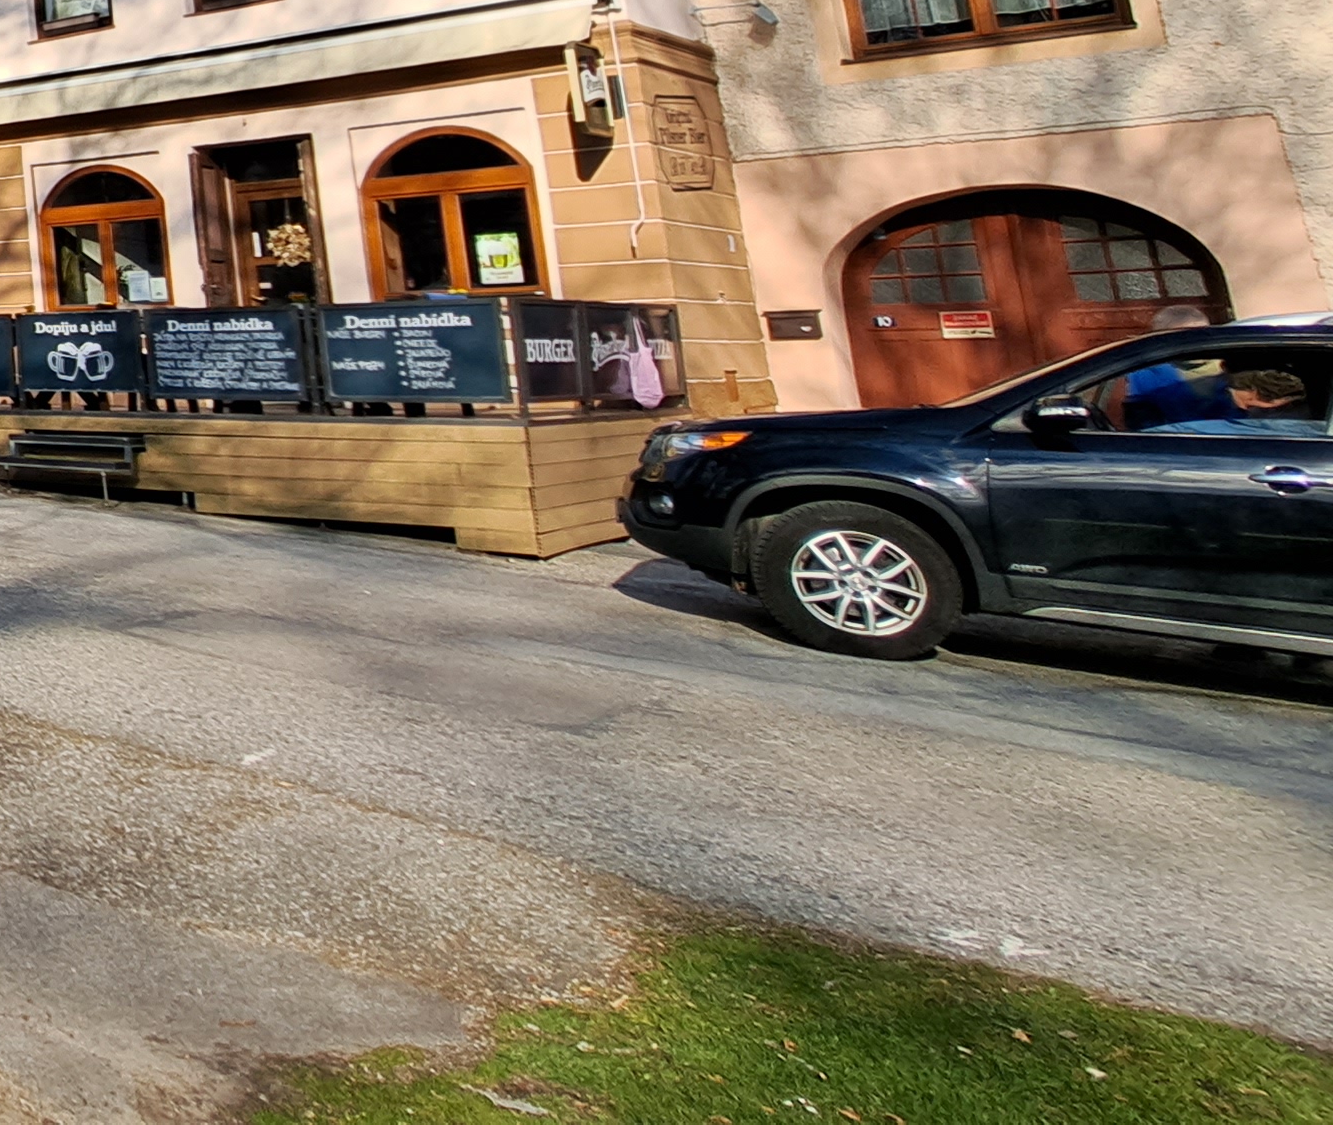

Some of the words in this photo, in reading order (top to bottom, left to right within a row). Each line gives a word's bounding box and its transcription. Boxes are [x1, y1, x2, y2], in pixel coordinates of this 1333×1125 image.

[34, 321, 78, 336] Dopiju
[80, 324, 89, 333] a
[89, 320, 117, 335] jdu!
[876, 316, 893, 327] 10
[525, 339, 575, 362] BURGER
